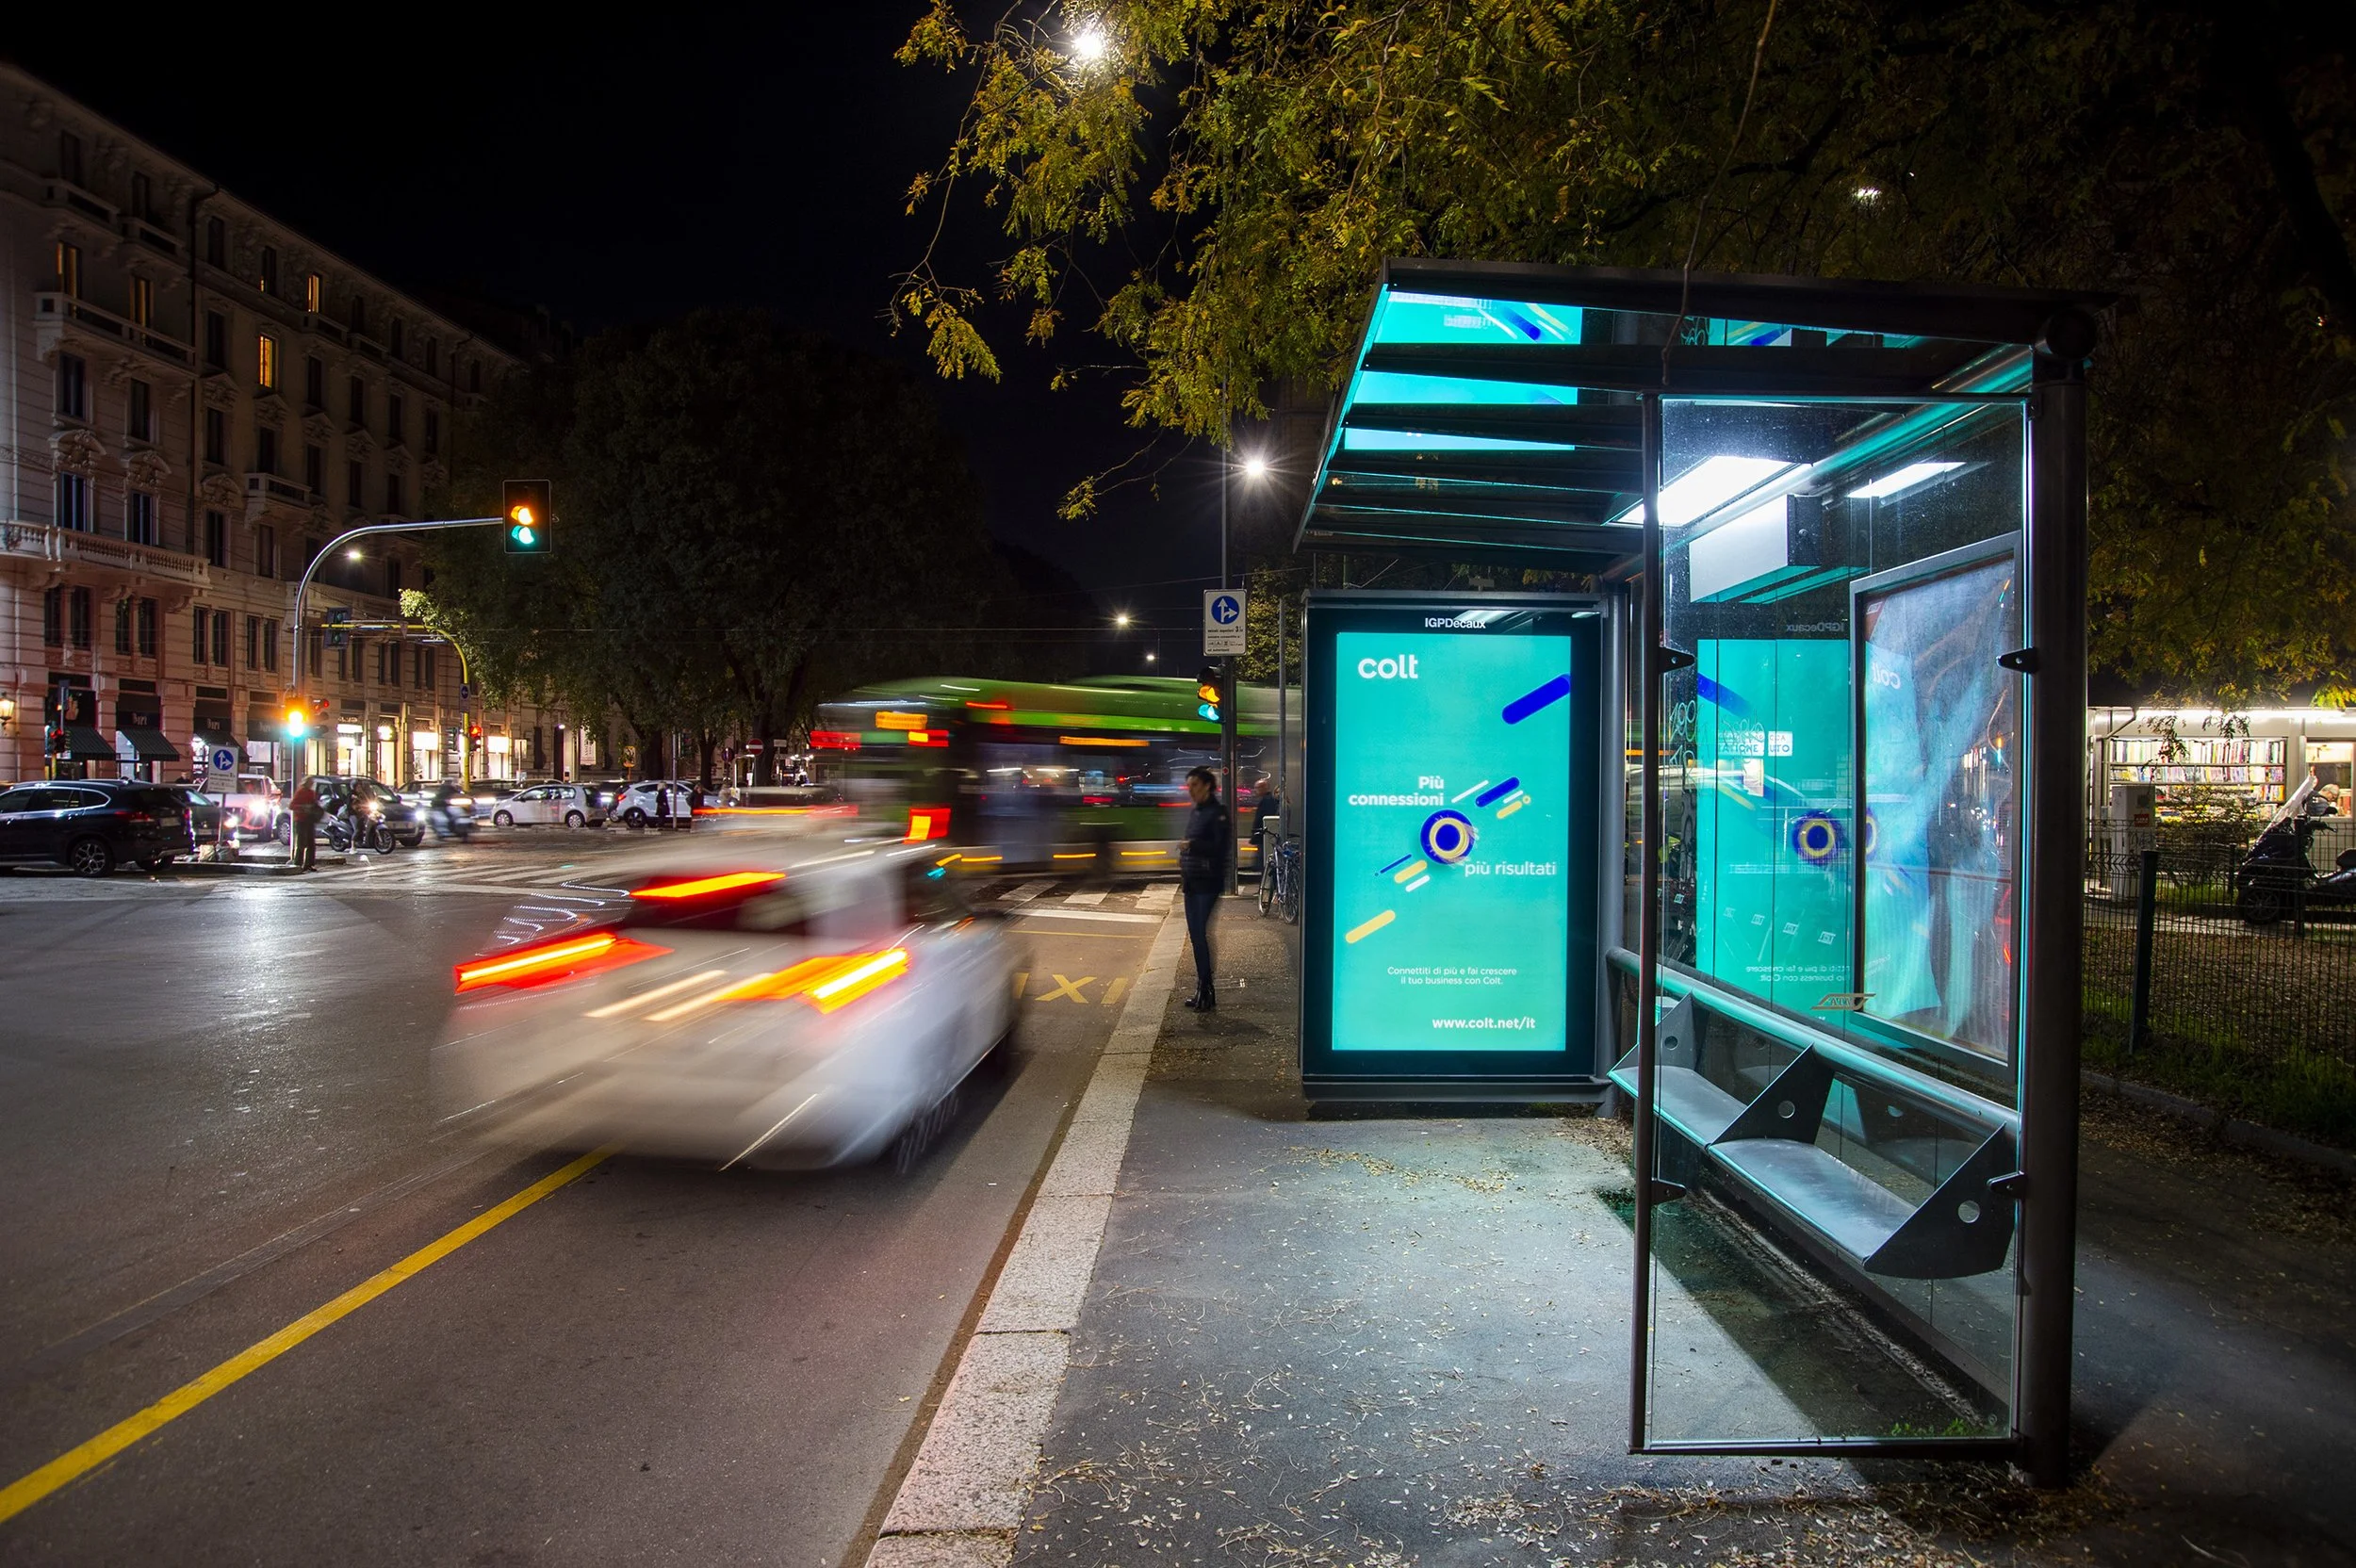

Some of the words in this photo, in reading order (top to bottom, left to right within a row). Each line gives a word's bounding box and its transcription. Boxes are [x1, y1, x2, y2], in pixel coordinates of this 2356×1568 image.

[1425, 617, 1486, 629] IGPDecaux
[1358, 655, 1418, 678] colt
[1418, 776, 1445, 790] Più
[1348, 792, 1445, 807] connessioni
[1464, 861, 1491, 877] più
[1495, 861, 1556, 875] risultati
[1387, 967, 1431, 975] Connettiti
[1432, 967, 1442, 975] di
[1443, 967, 1458, 977] più
[1467, 967, 1479, 975] fai
[1400, 976, 1406, 985] il
[1408, 976, 1424, 985] tuo
[1425, 976, 1463, 985] business
[1482, 976, 1504, 985] Colt.
[1432, 1016, 1536, 1031] www.colt.net/it
